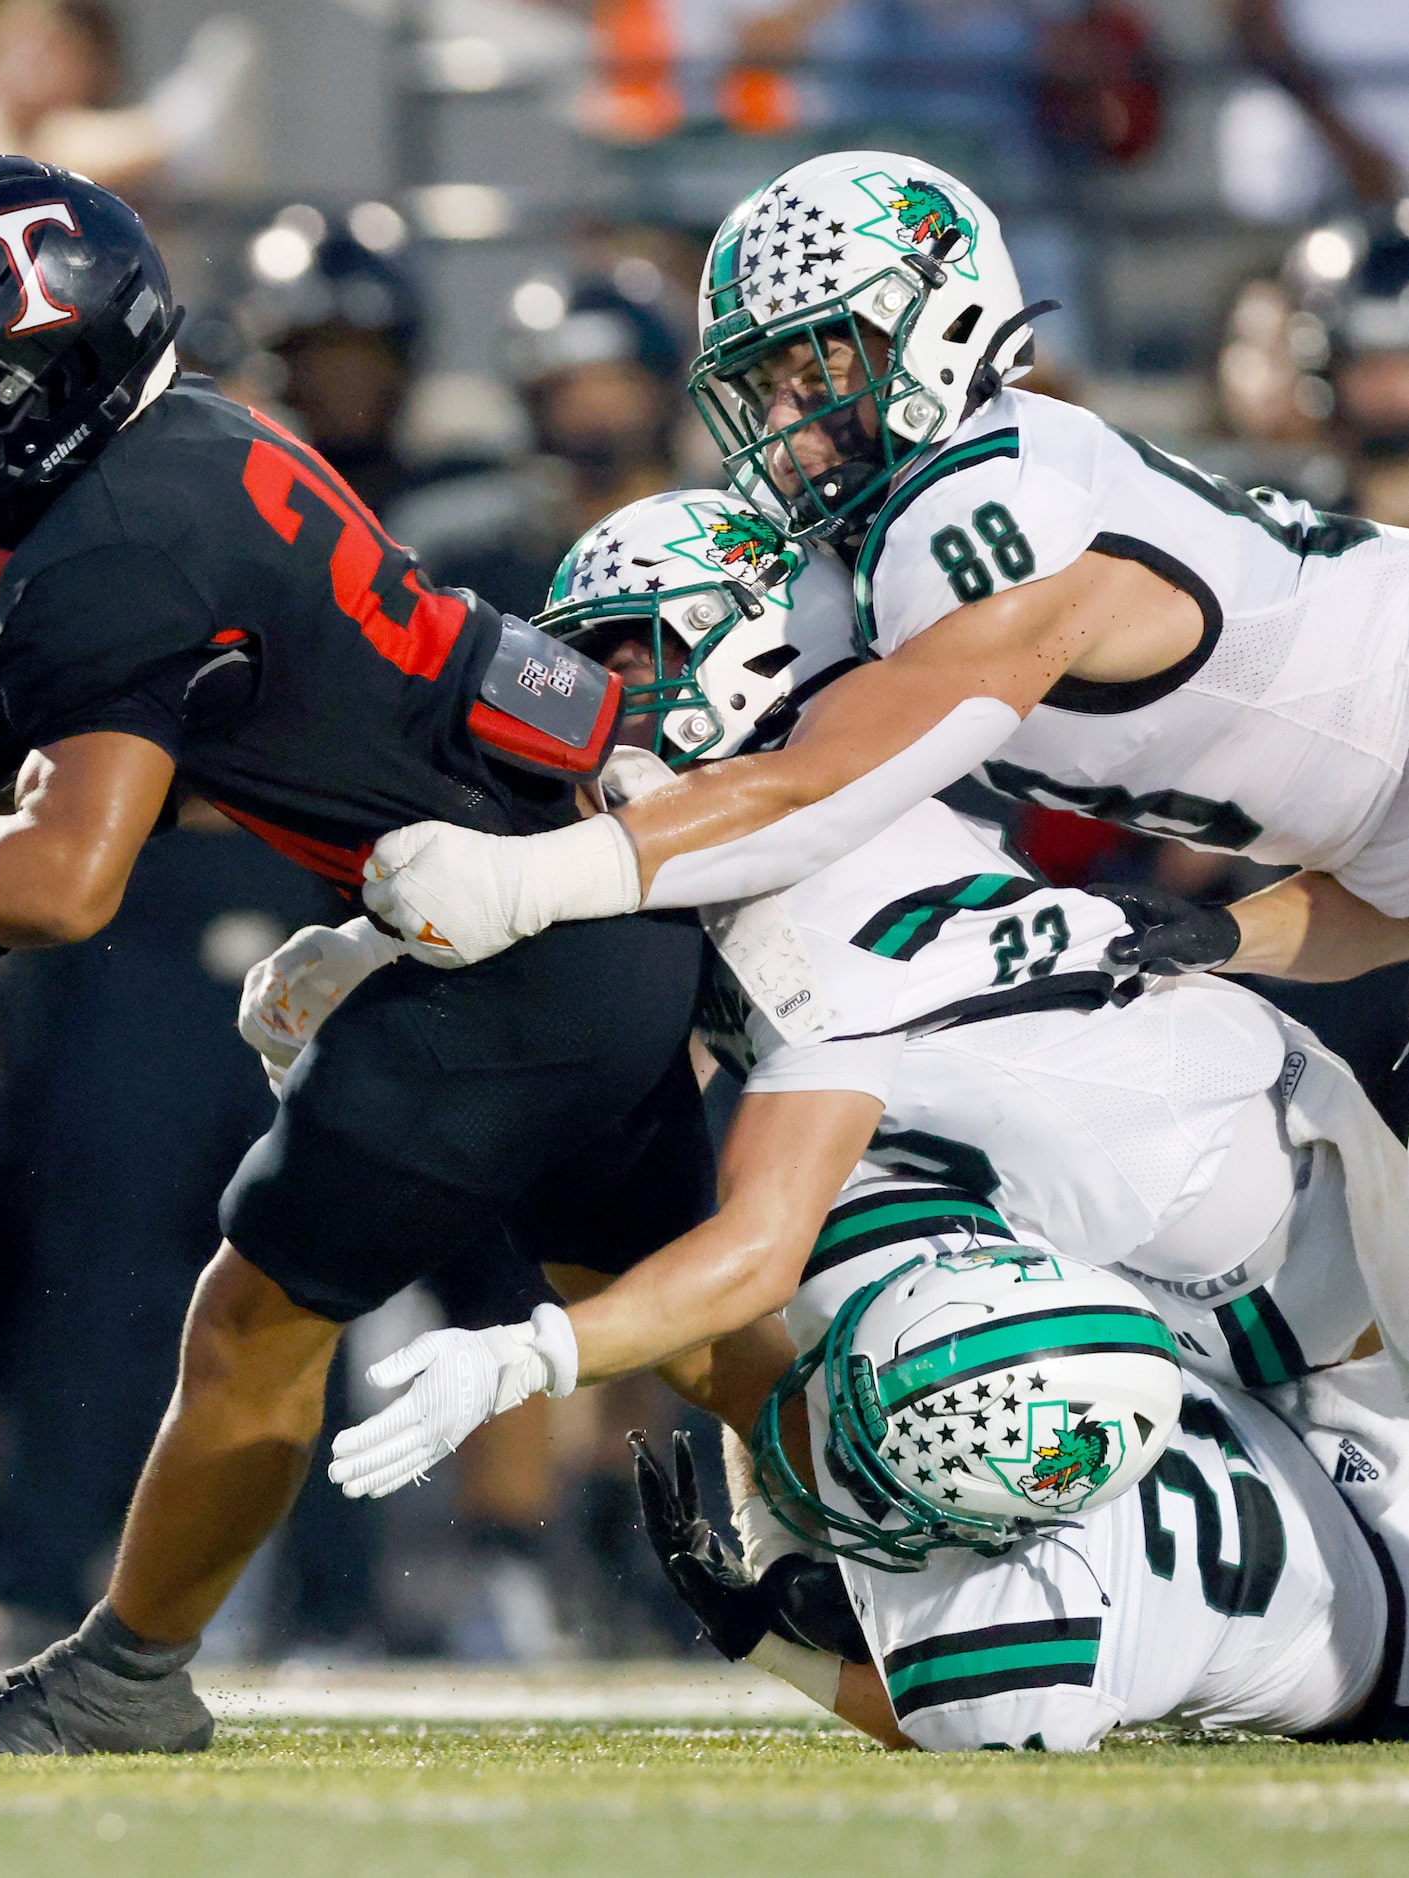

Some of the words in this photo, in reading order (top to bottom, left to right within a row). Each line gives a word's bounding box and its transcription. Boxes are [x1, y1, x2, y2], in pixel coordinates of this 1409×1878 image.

[41, 422, 92, 473] schutt
[930, 500, 1036, 605] 88
[517, 656, 549, 697] PRO
[547, 656, 579, 698] GEAR
[778, 991, 808, 1017] BATTLE
[1339, 1438, 1379, 1480] adidas
